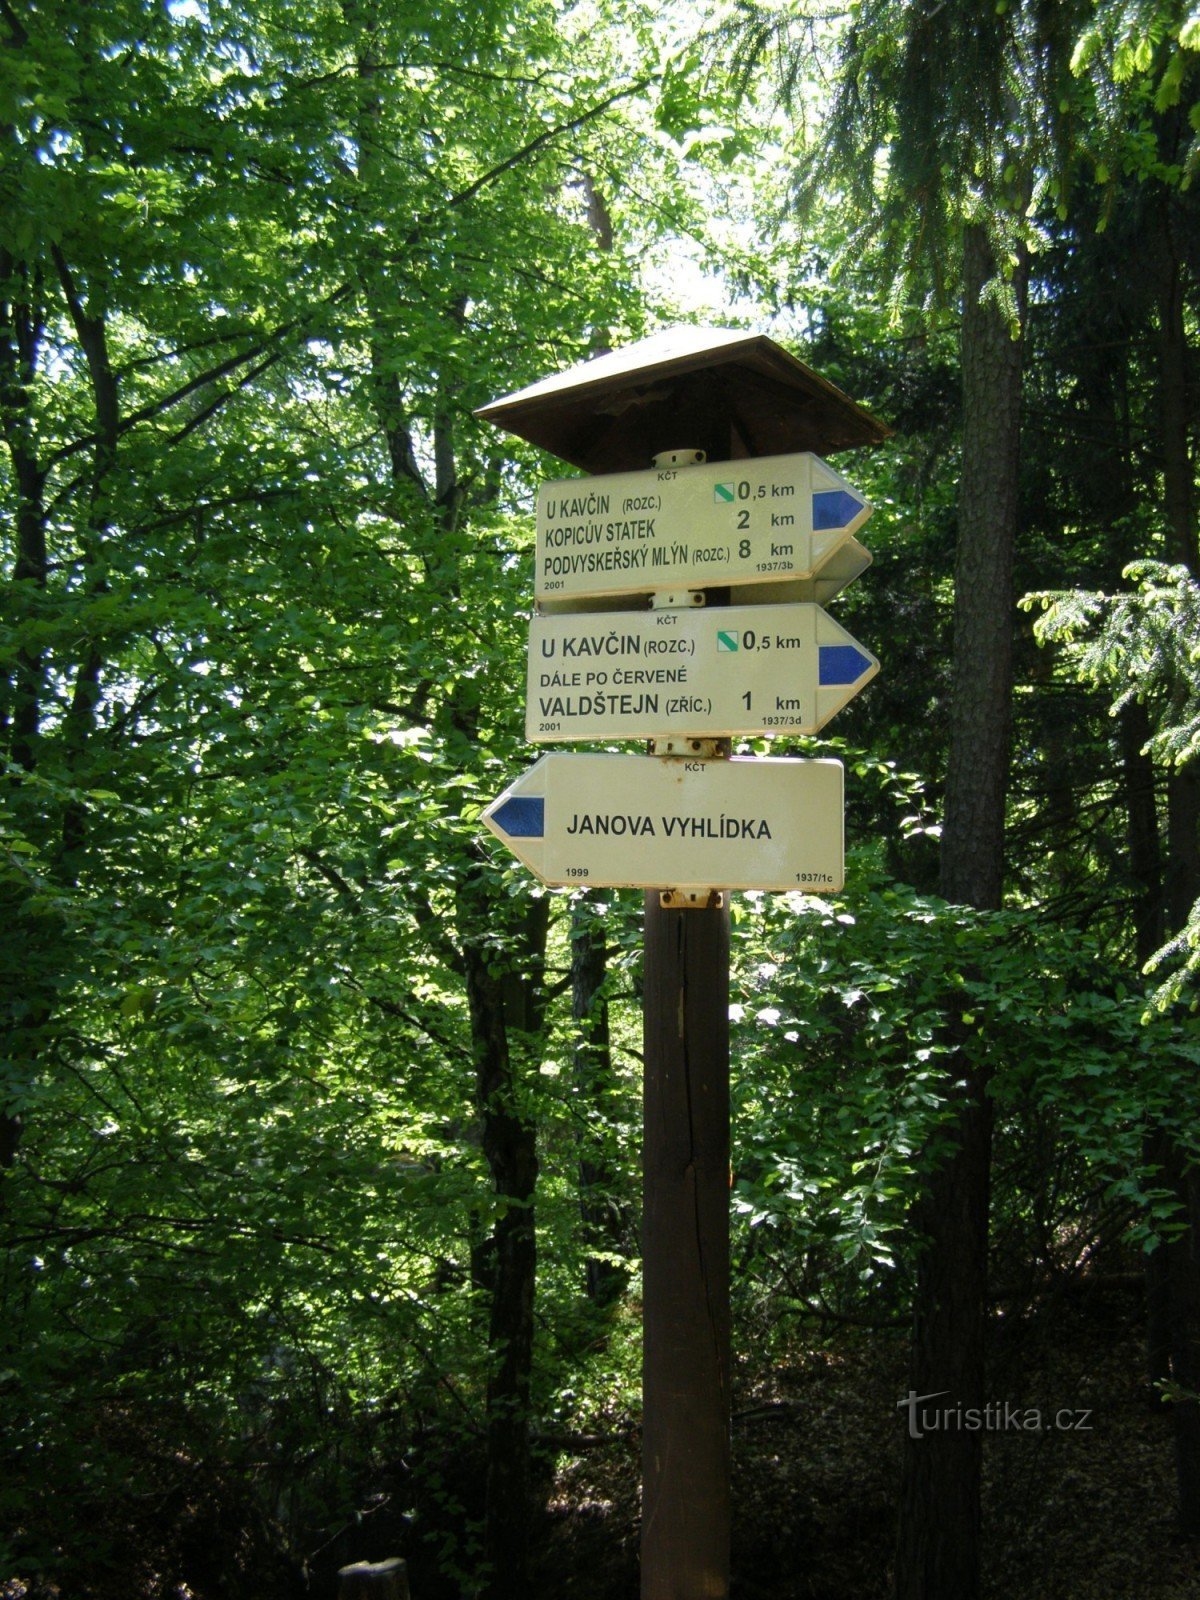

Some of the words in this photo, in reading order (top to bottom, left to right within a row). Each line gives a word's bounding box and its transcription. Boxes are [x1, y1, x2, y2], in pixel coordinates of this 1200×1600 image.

[657, 471, 677, 481] KČT
[547, 500, 555, 519] U
[560, 492, 609, 518] KAVČIN
[622, 495, 661, 513] (ROZC.)
[771, 484, 794, 496] km
[606, 519, 655, 542] STATEK
[737, 510, 750, 529] 2
[771, 514, 794, 525] km
[544, 543, 648, 576] PODVYSKEŘSKÝ
[652, 540, 688, 566] MLÝN
[692, 547, 730, 565] (ROZC.)
[739, 539, 751, 558] 8
[771, 543, 793, 556] km
[756, 561, 793, 572] 1937/3b
[544, 581, 565, 590] 2001
[657, 615, 678, 625] KČT
[542, 639, 555, 657] U
[563, 632, 641, 657] KAVČIN
[643, 639, 695, 657] (ROZC.)
[776, 636, 800, 648] km
[541, 670, 581, 687] DÁLE
[586, 672, 607, 686] PO
[612, 665, 687, 685] ČERVENÉ
[539, 692, 658, 716] VALDŠTEJN
[666, 697, 712, 716] (ZŘÍC.)
[742, 691, 752, 710] 1
[776, 697, 800, 710] km
[539, 722, 561, 731] 2001
[761, 716, 802, 727] 1937/3d
[685, 762, 706, 772] KČT
[567, 814, 655, 836] JANOVA
[662, 813, 772, 840] VYHLÍDKA
[565, 868, 589, 877] 1999
[796, 873, 833, 883] 1937/1c
